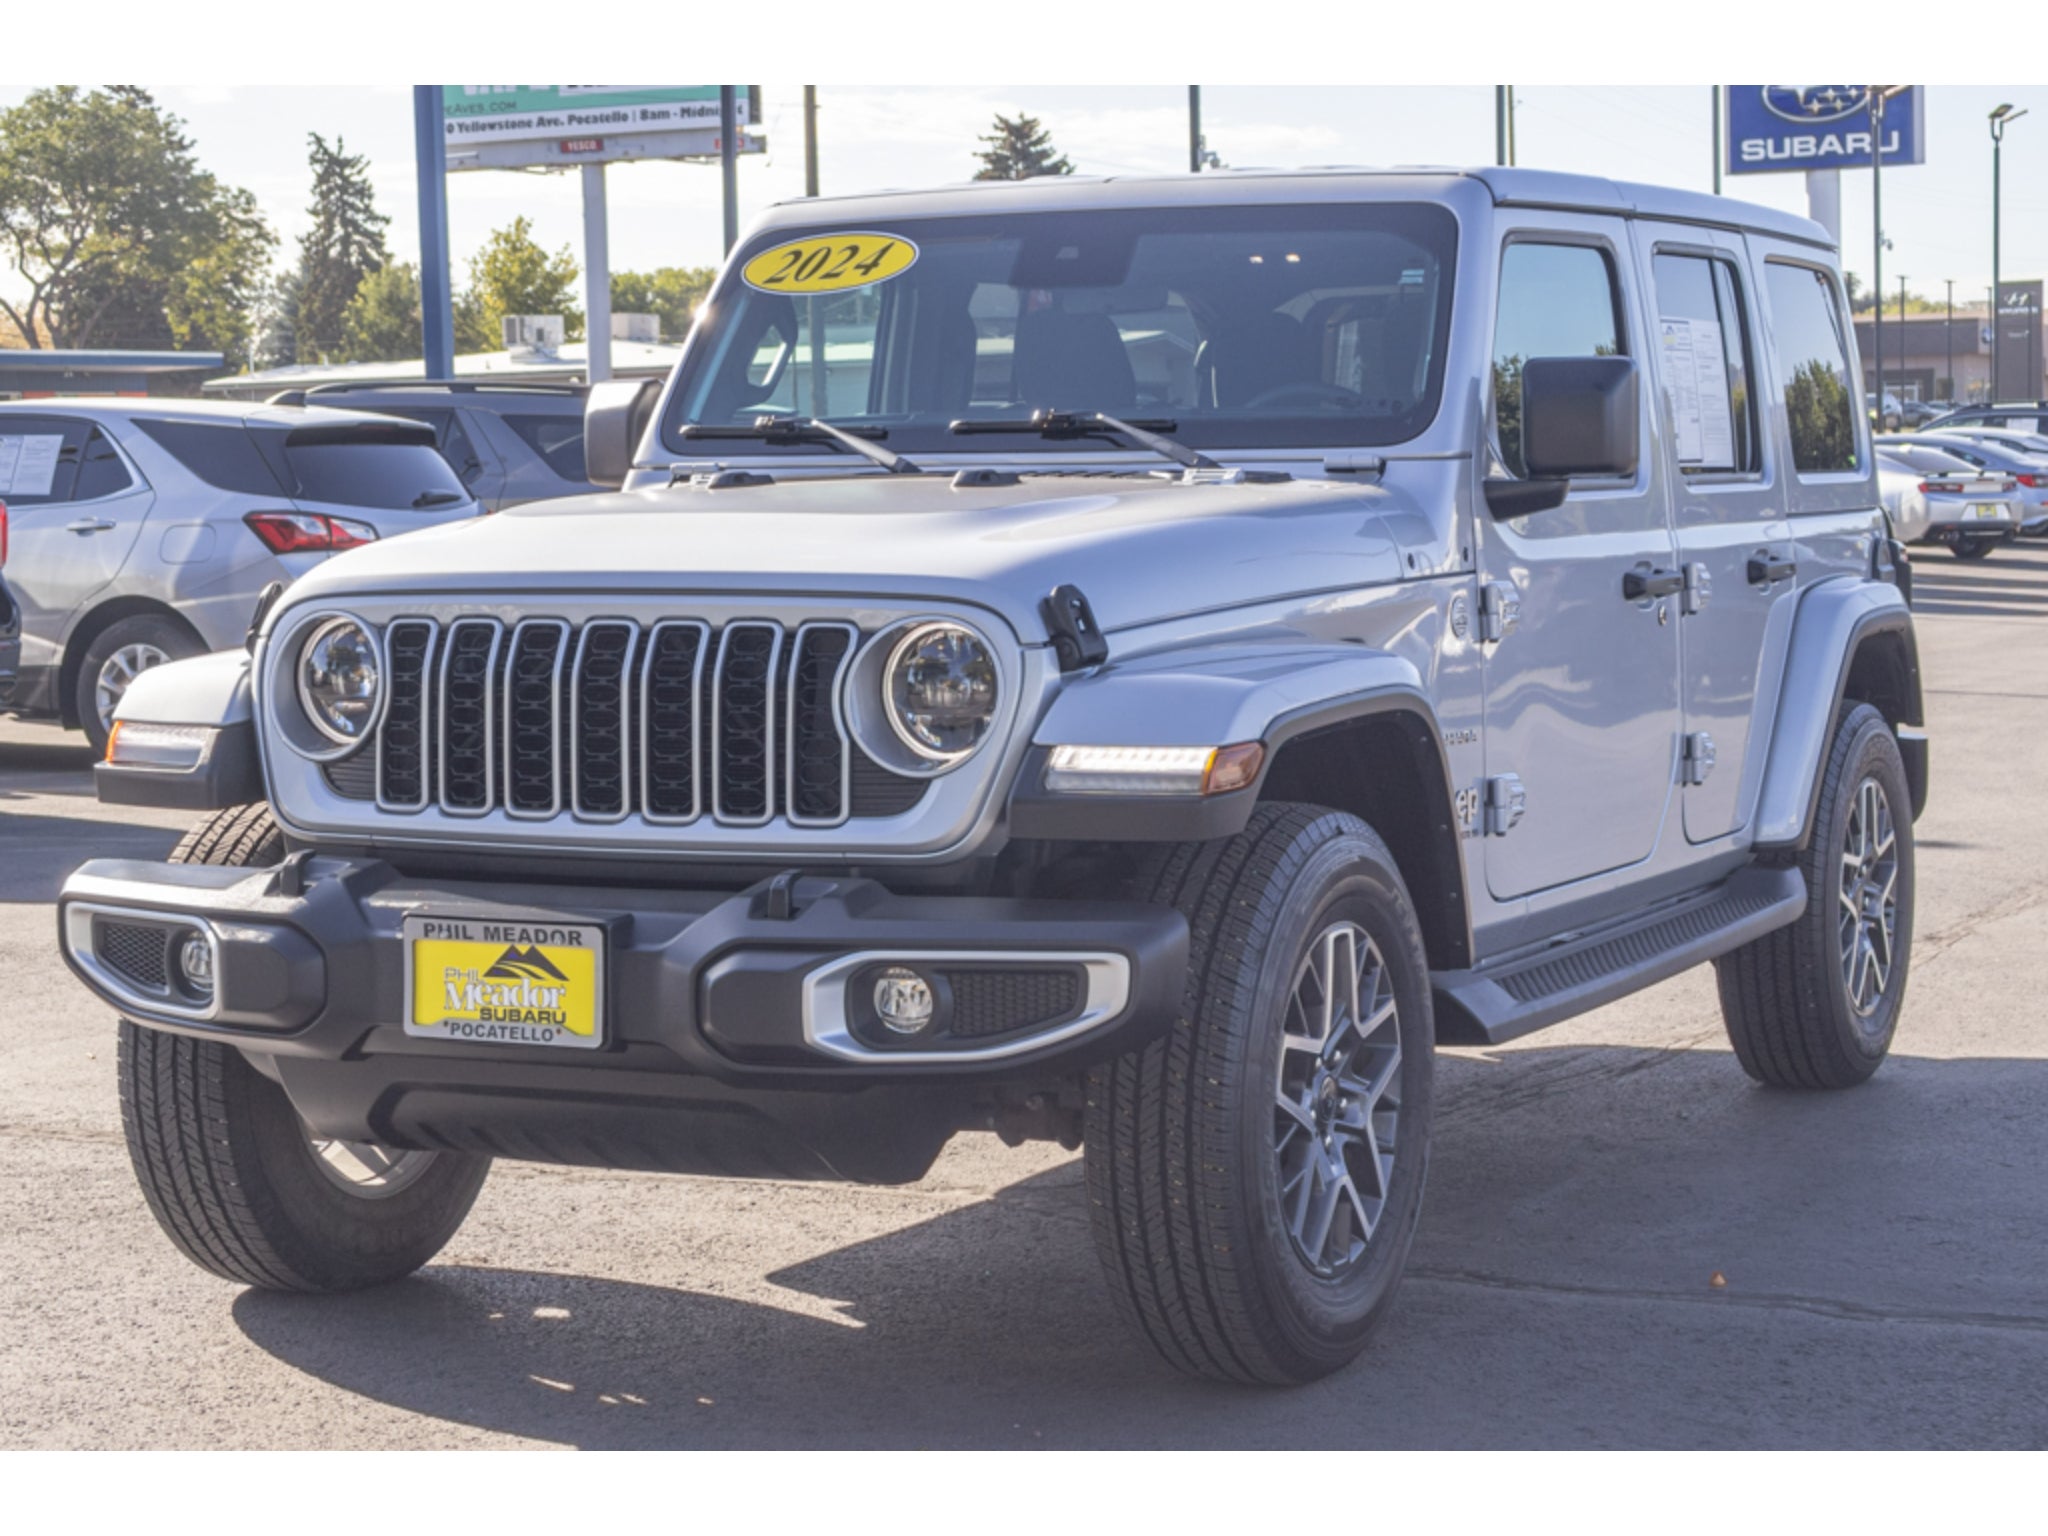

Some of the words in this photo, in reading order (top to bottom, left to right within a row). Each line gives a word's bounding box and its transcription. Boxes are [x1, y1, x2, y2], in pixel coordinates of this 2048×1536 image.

[456, 118, 533, 133] Yellowstone
[536, 115, 565, 127] Ave.
[567, 110, 629, 126] Pocatello
[640, 109, 670, 121] 8am
[680, 104, 743, 119] Midnit
[1741, 130, 1899, 161] SUBARU
[761, 241, 896, 285] 2024
[423, 922, 475, 940] PHIL
[483, 926, 583, 946] MEADOR
[444, 966, 482, 982] PHIL
[444, 977, 567, 1011] Meador
[480, 1008, 566, 1024] SUBARU
[450, 1022, 554, 1042] POCATELLO
